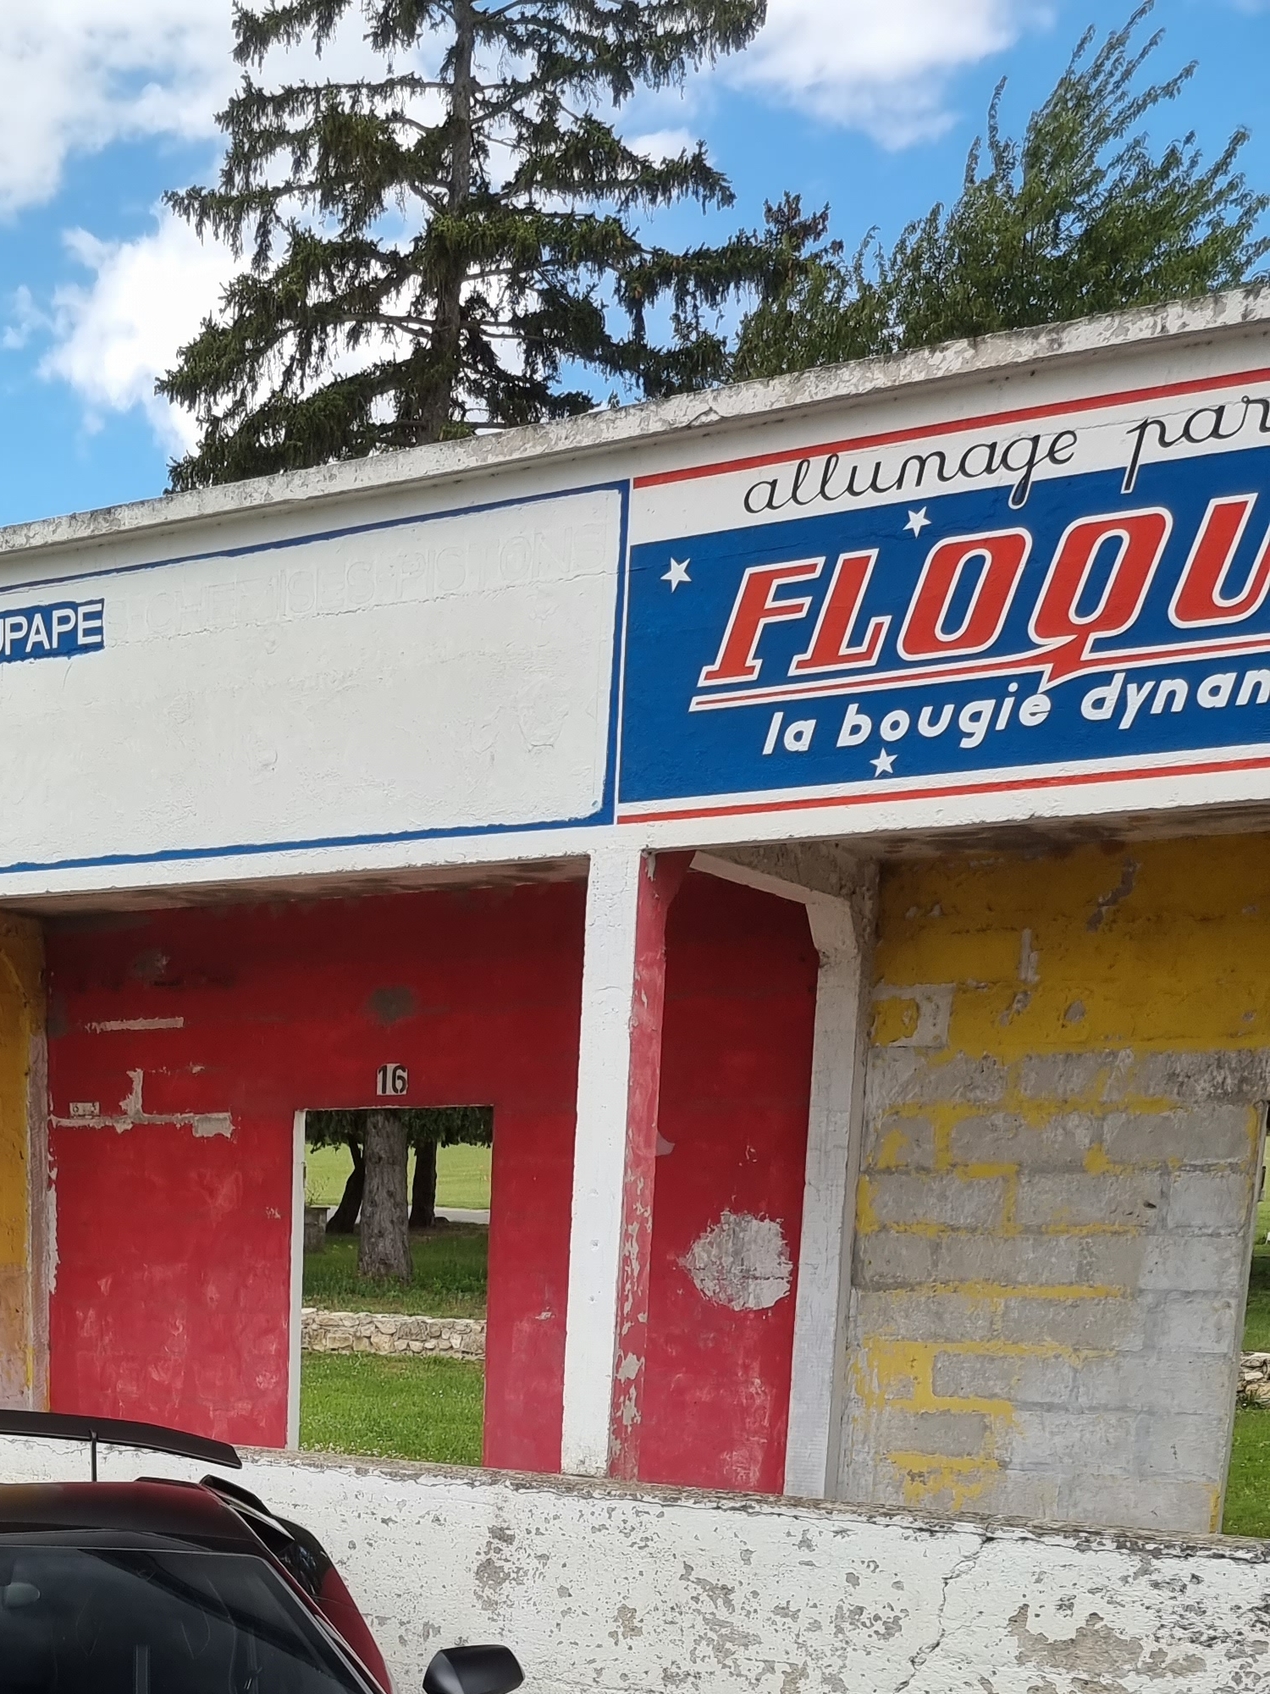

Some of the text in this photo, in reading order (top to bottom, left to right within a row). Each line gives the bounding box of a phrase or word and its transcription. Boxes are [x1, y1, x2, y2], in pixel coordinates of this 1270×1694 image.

[744, 430, 1078, 515] allumage
[698, 493, 1270, 692] FLOQU
[762, 711, 817, 756] la
[837, 683, 1052, 750] bougie
[378, 1064, 407, 1094] 16
